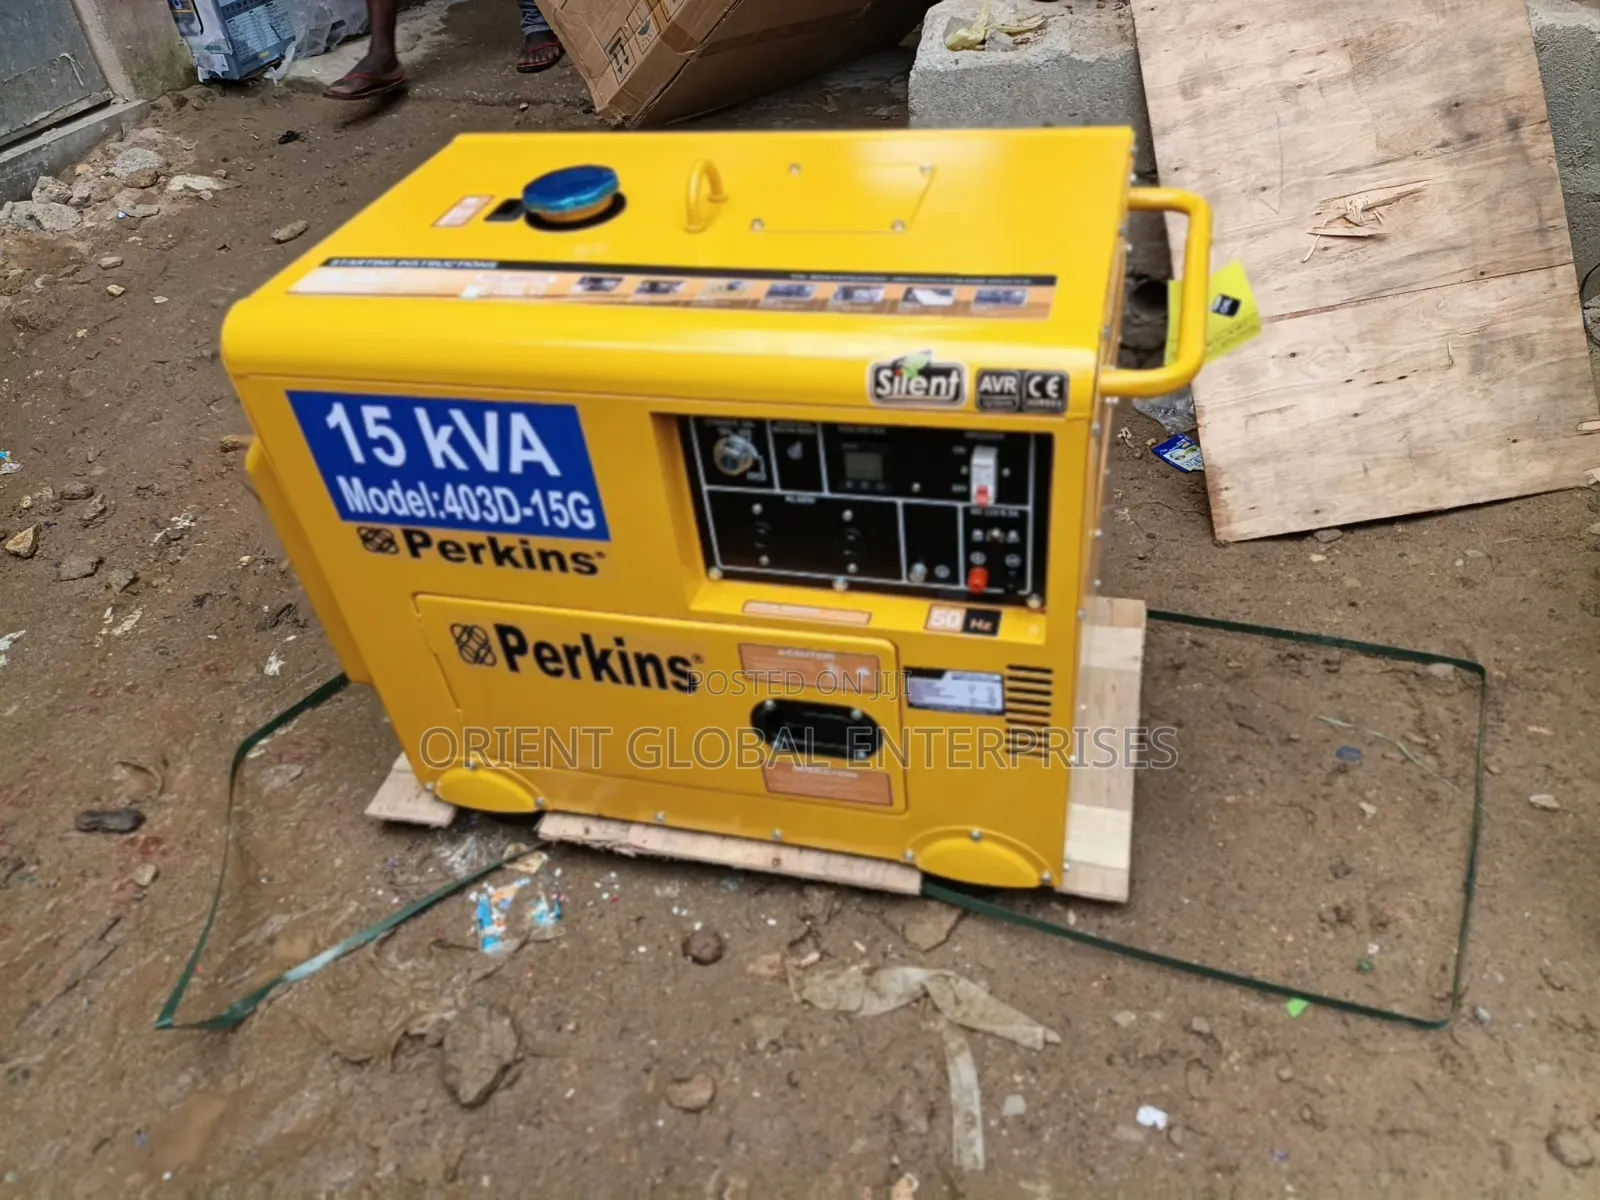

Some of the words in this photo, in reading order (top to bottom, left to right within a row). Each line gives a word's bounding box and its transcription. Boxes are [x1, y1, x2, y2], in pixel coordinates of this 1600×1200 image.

[876, 369, 960, 398] Silent
[979, 374, 1017, 393] AVR
[325, 402, 407, 467] 15
[413, 406, 562, 477] kVA
[335, 474, 597, 531] Model:403D-15G
[402, 528, 600, 576] Perkins
[494, 623, 698, 694] Perkins
